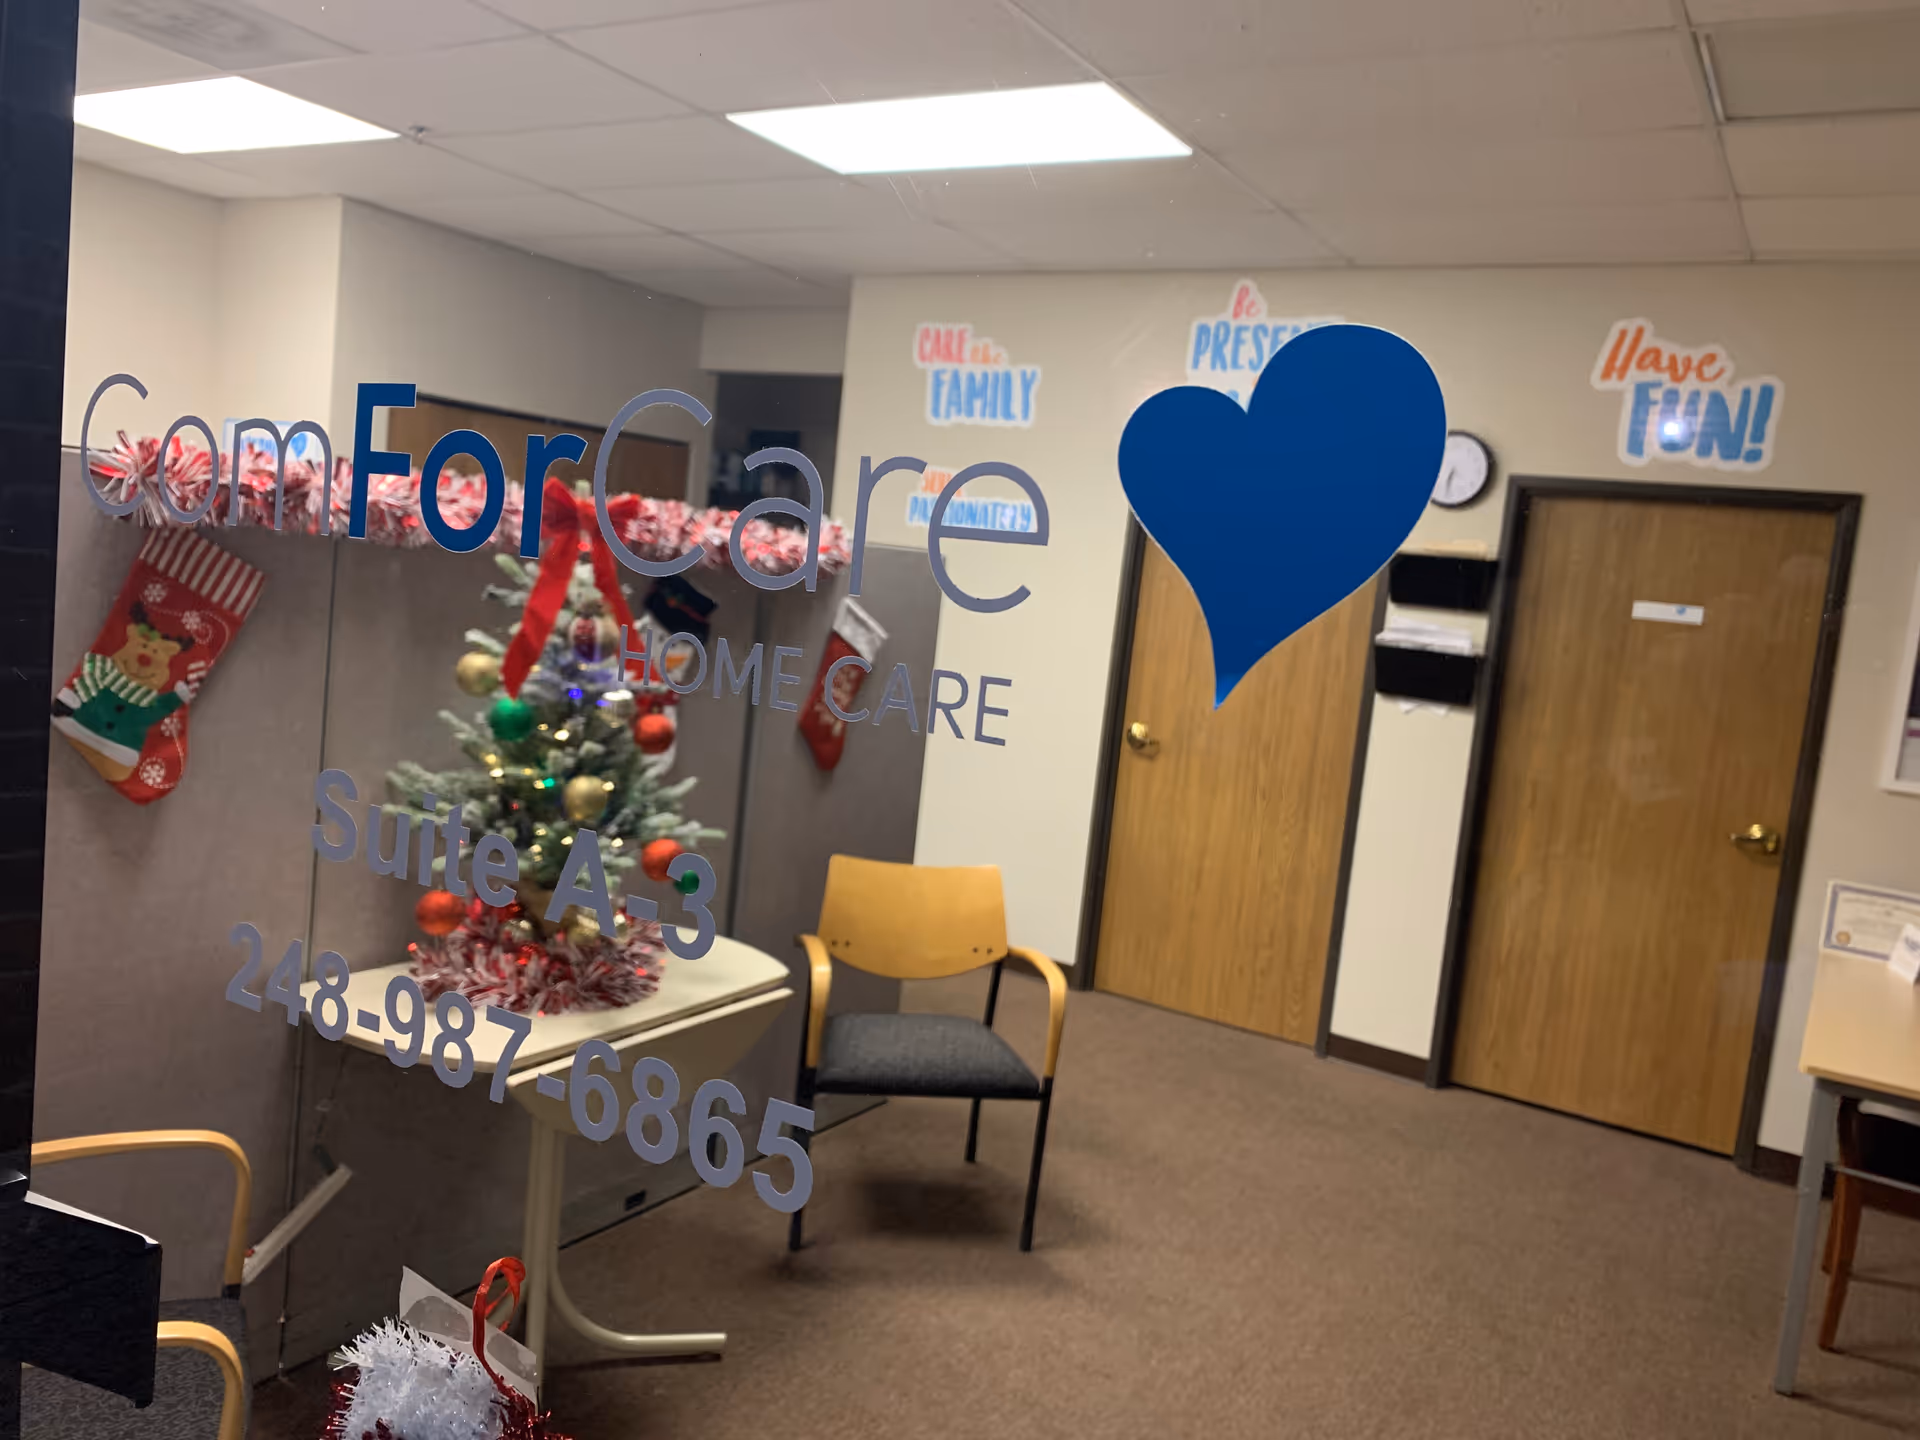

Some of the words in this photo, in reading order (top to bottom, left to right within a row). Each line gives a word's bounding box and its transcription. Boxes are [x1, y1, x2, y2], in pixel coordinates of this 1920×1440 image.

[930, 367, 1038, 421] FAMILY
[1601, 325, 1725, 383] Have
[1626, 381, 1775, 463] FUN!
[81, 373, 1050, 613] ComForCare
[618, 624, 804, 712] HOME
[824, 655, 1013, 746] CARE
[312, 769, 520, 907] Suite
[544, 828, 717, 960] A-3
[225, 923, 816, 1213] 248-987-6865
